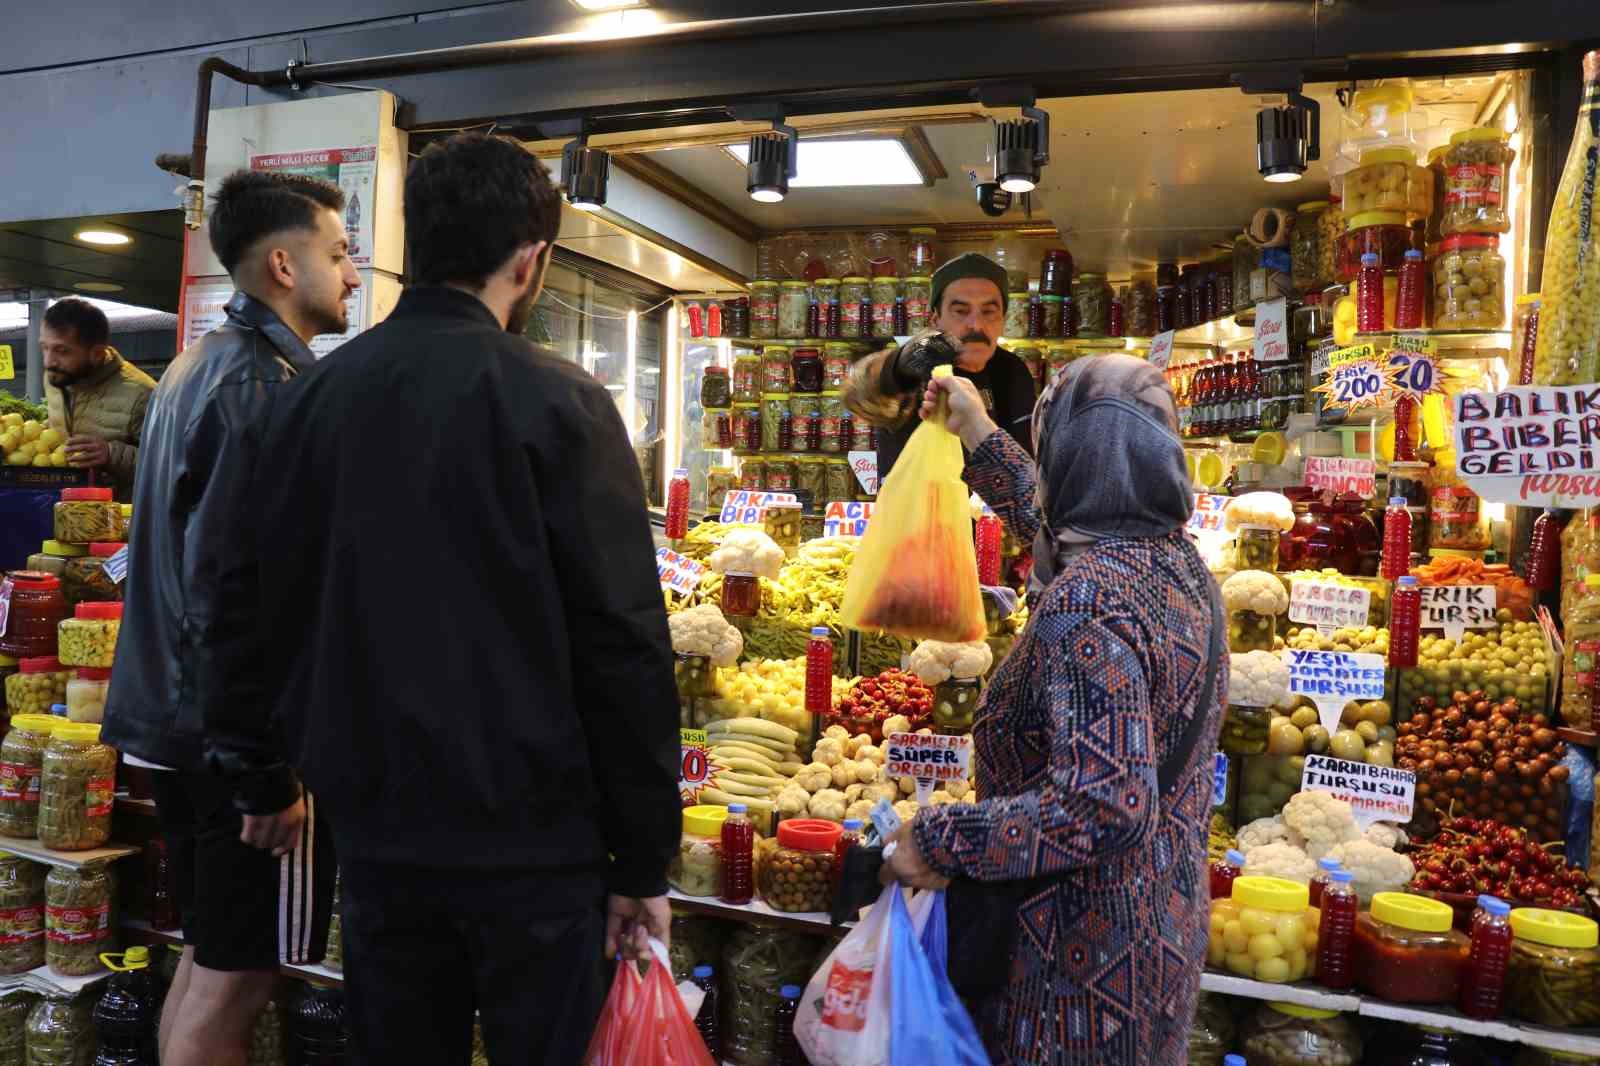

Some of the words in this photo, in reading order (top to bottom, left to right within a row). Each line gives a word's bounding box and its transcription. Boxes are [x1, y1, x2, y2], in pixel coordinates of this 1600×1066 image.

[1336, 374, 1380, 402] 200
[1291, 677, 1385, 697] TURŞUSU
[889, 747, 960, 764] SÜPER
[1304, 771, 1407, 798] TURŞUSU
